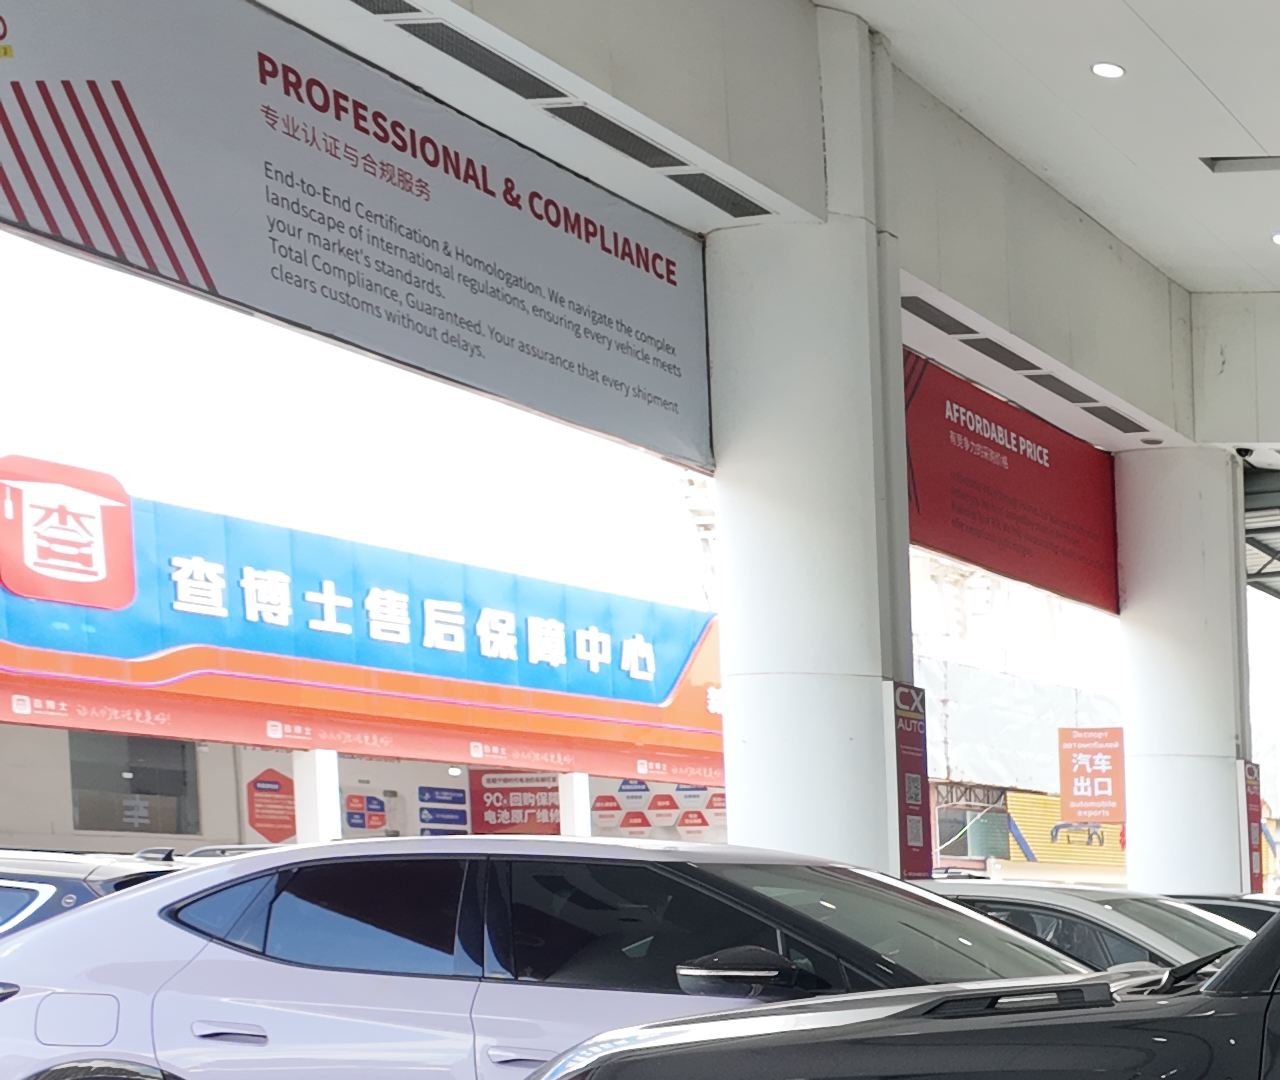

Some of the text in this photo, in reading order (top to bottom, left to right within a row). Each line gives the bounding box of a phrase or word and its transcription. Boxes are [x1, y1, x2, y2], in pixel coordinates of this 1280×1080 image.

[257, 51, 677, 286] PROFESSIONAL & COMPLIANCE
[260, 104, 431, 202] 专业认证与合规服务
[264, 161, 677, 356] End-to-End Certification & Homologation. We navigate the complex
[265, 185, 682, 378] landscape of international regulations, ensuring every vehicle meets
[266, 214, 446, 299] your market's standards.
[268, 236, 680, 415] Total Compliance, Guaranteed. Your assurance that every shipment
[270, 264, 486, 360] clears customs without delays.
[945, 400, 1050, 467] AFFORDABLE PRICE
[169, 556, 656, 681] 查博士售后保障中心
[895, 686, 925, 713] CX
[1071, 752, 1112, 773] 汽车
[1073, 776, 1112, 797] 出口
[1077, 809, 1110, 818] exports
